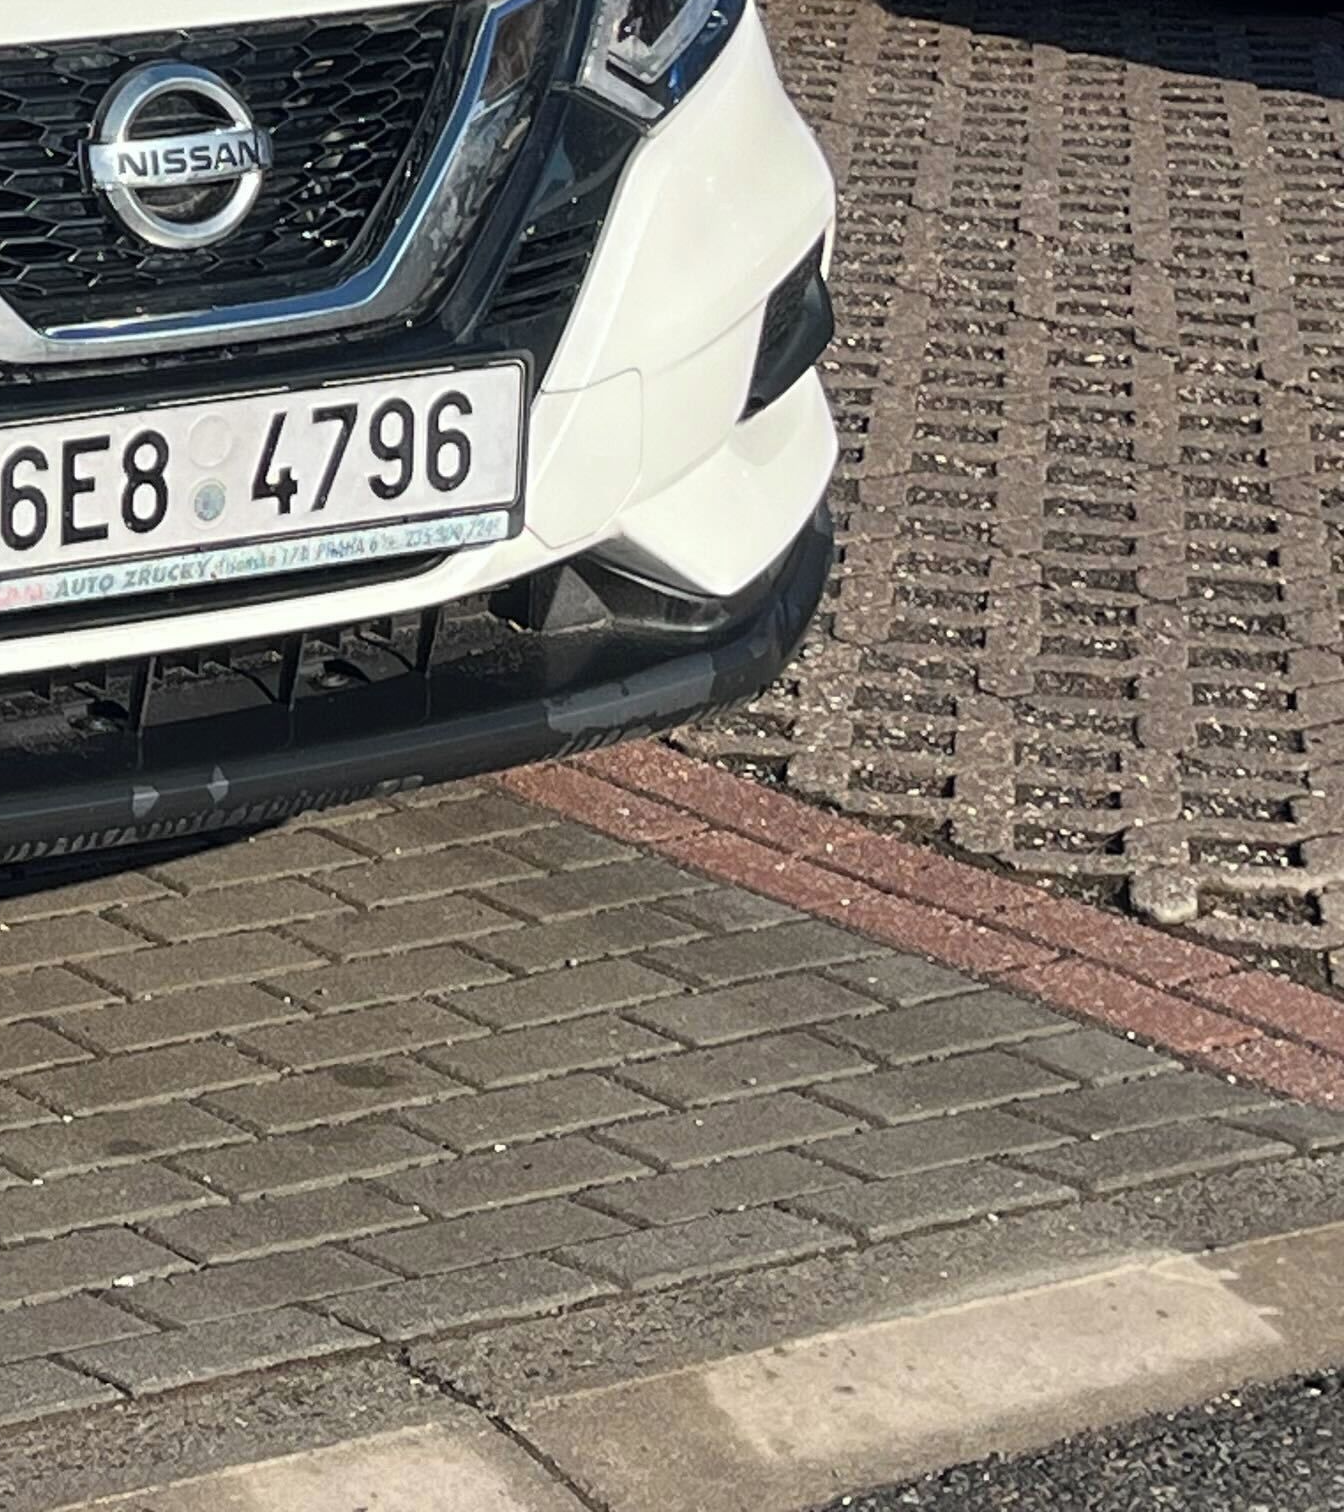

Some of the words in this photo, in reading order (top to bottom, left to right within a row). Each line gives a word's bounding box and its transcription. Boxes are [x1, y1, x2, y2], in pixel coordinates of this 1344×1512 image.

[117, 139, 261, 178] NISSAN
[0, 429, 170, 552] 6E8
[251, 389, 474, 515] 4796
[53, 572, 115, 600] AUTO
